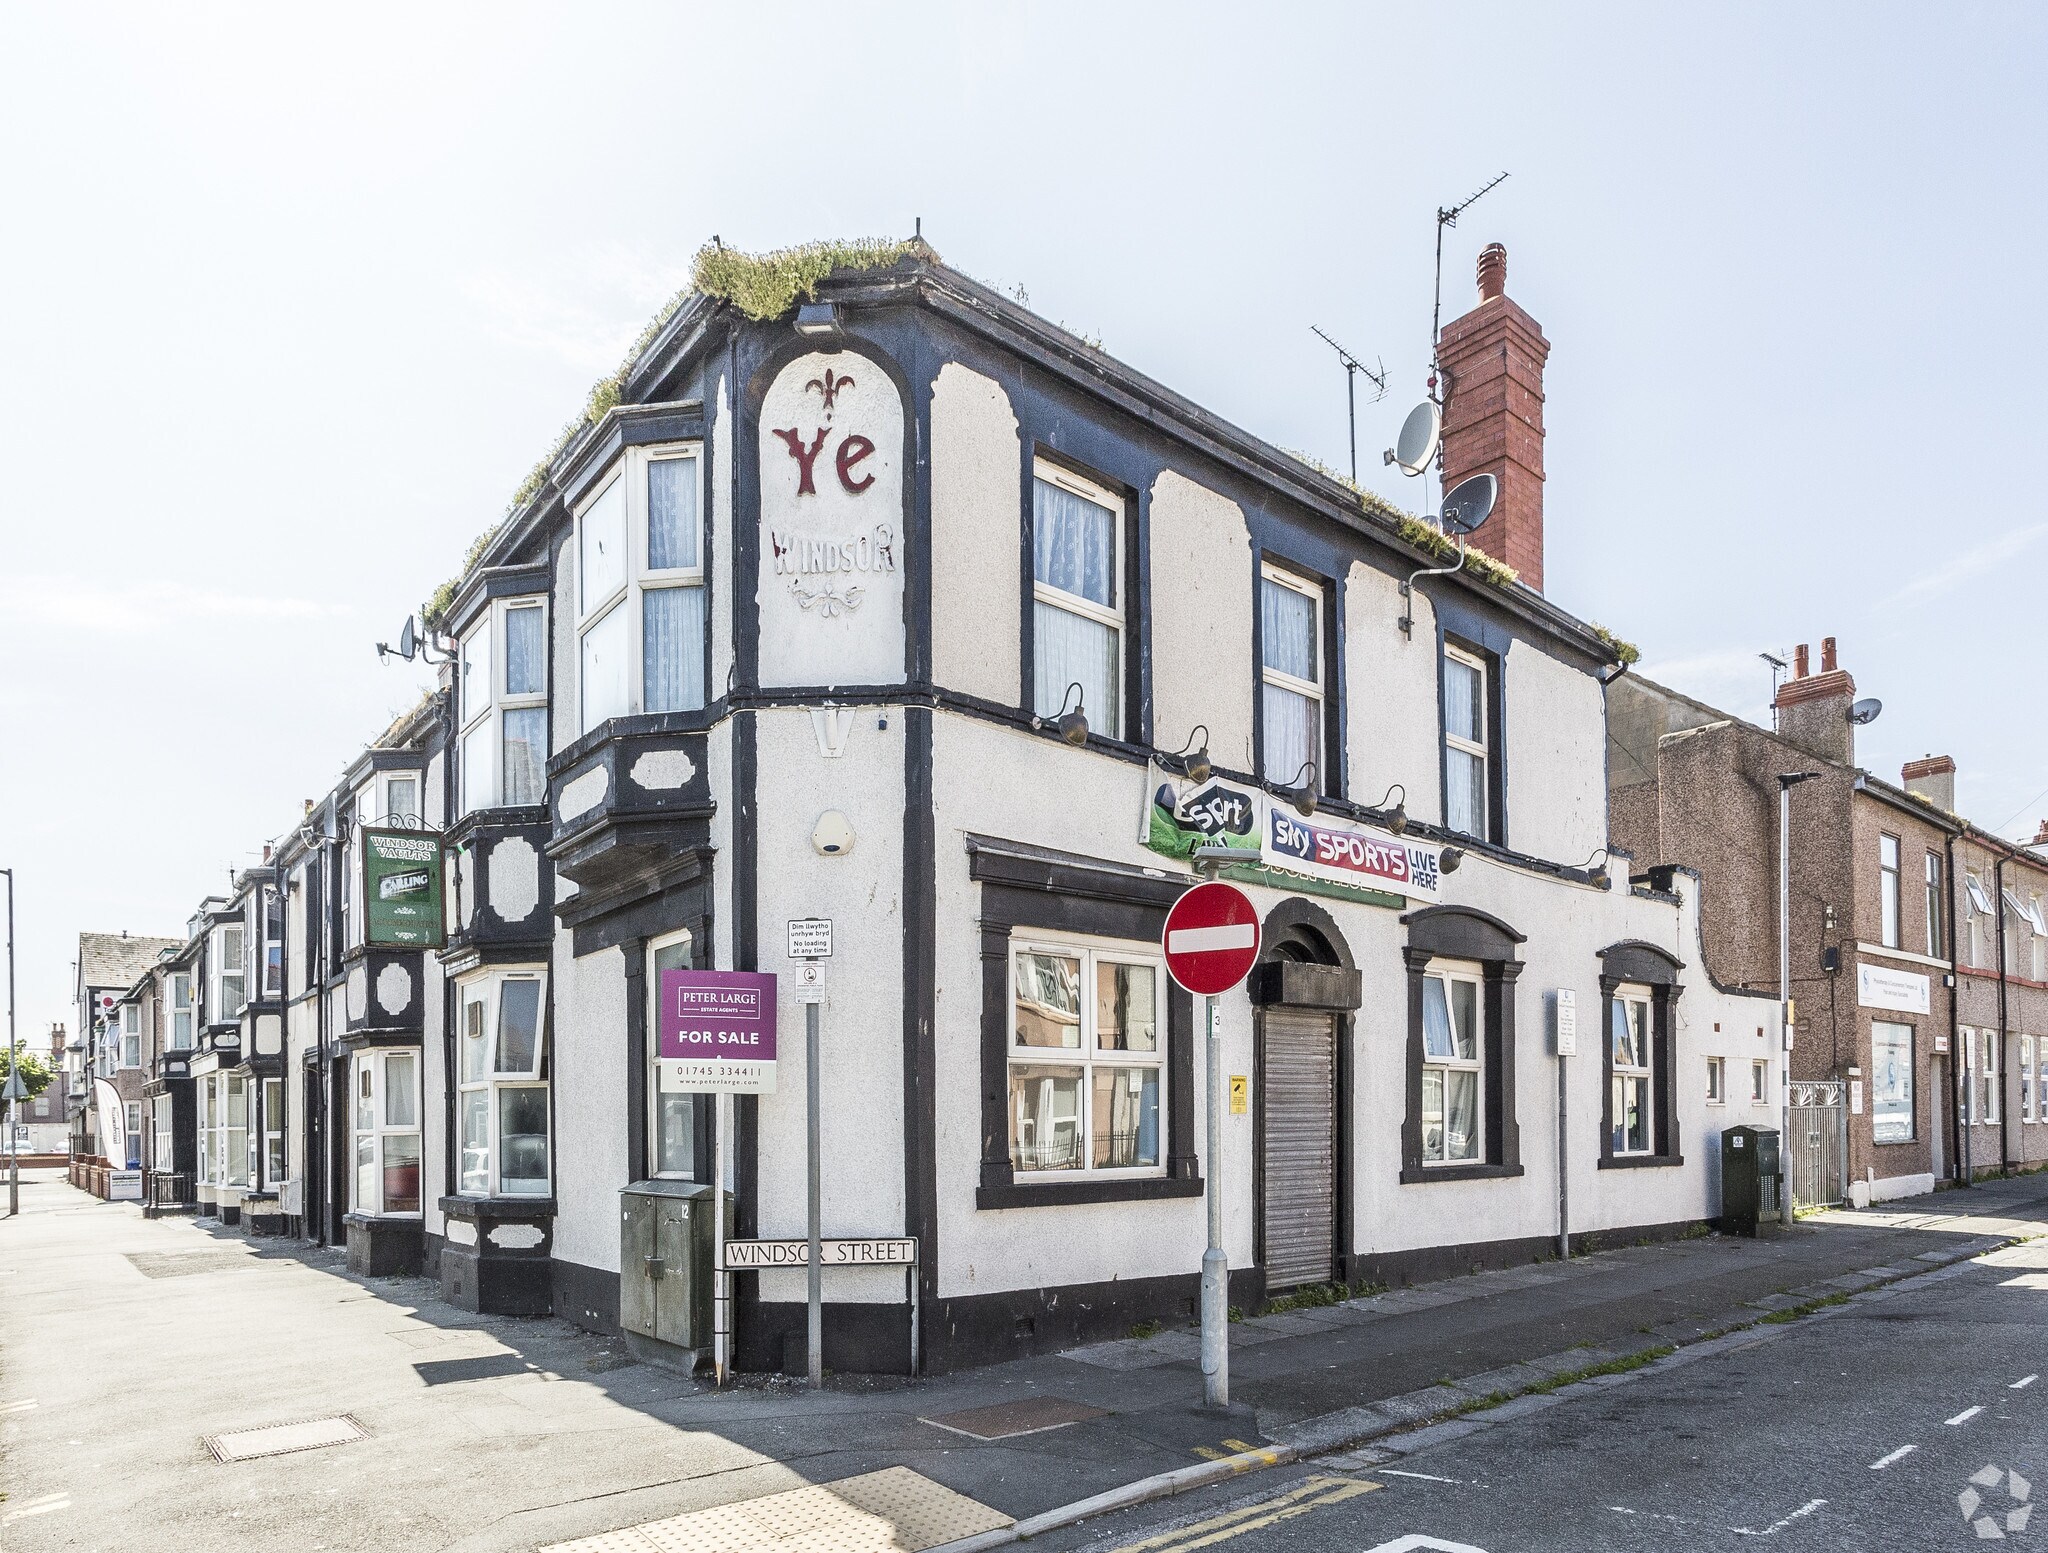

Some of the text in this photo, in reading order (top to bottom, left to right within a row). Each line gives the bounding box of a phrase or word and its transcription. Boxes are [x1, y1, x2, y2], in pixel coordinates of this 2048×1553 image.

[772, 427, 876, 496] Ye
[771, 523, 895, 575] WINDSOR
[370, 836, 437, 851] WINDSOR
[377, 848, 431, 861] VAULTS
[1315, 832, 1406, 876] SPORTS
[1408, 848, 1438, 873] LIVE
[1411, 868, 1438, 892] HERE
[805, 923, 829, 931] llwytho
[683, 993, 756, 1004] PETER LARGE
[679, 1031, 760, 1045] FOR SALE
[677, 1067, 761, 1076] 01745 334411
[837, 1242, 911, 1262] STREET
